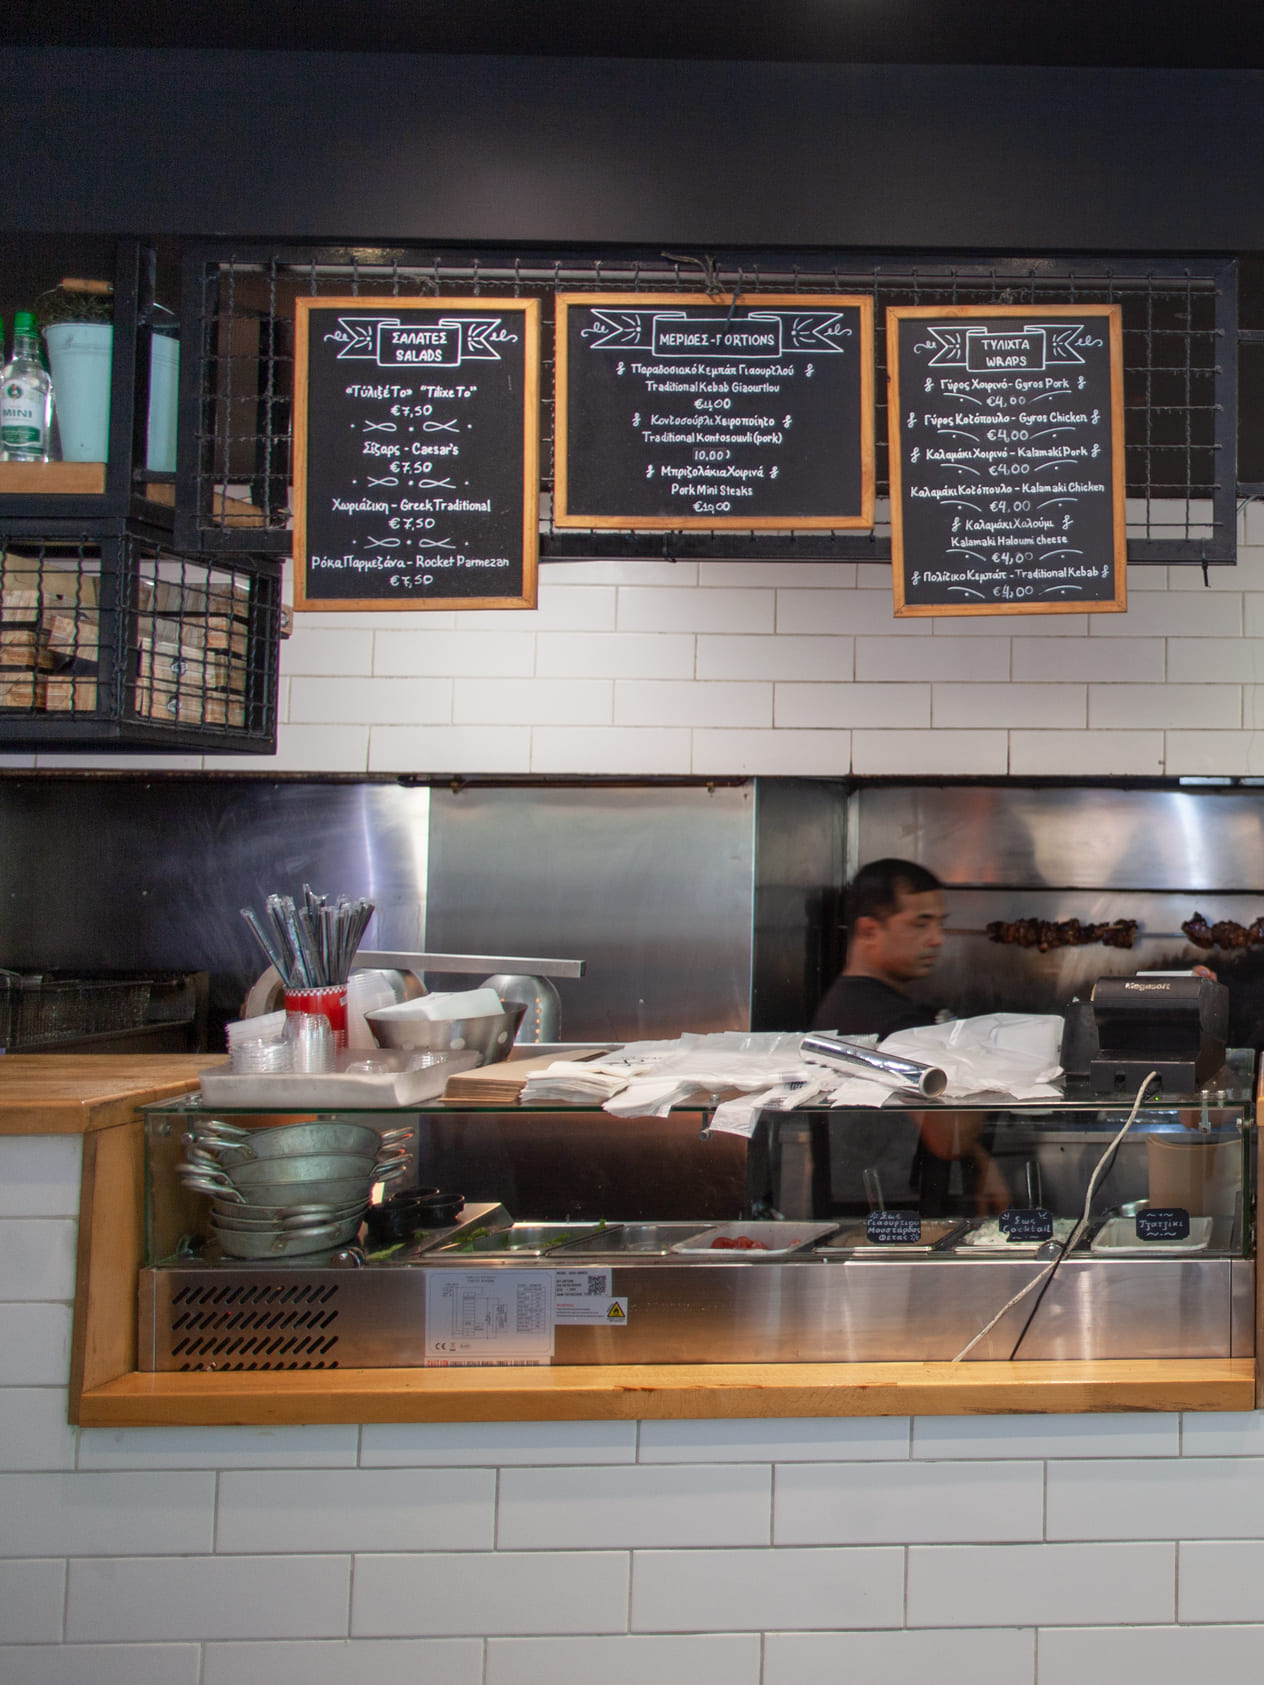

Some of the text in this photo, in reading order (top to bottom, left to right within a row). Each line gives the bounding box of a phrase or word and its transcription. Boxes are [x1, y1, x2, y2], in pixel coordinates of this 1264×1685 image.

[392, 332, 448, 345] ΣΑΛΑΤΕΣ
[981, 339, 1030, 350] ΤΥΛΙΧΤΑ
[395, 348, 443, 362] SALADS
[985, 355, 1027, 367] WRAPS
[631, 363, 697, 377] Παραδοσιακό
[698, 363, 737, 377] Κεμπάπ
[645, 380, 780, 393] Traditional Kebab Giaourtlou
[940, 379, 970, 393] Γύρος
[971, 378, 1008, 393] Χοιρινό
[1014, 379, 1043, 391] Gyros
[1045, 378, 1070, 390] Pork
[2, 408, 32, 419] MINI
[390, 404, 433, 418] €7,50
[651, 414, 775, 429] Κοντοσούβλι Χειροποίητο
[924, 414, 954, 428] Γύρος
[955, 412, 1010, 426] Κοτόπουλο
[1018, 412, 1047, 426] Gyros
[1049, 411, 1088, 423] Chicken
[642, 431, 783, 445] Traditional Kontosouvli (pork)
[987, 429, 1029, 443] €4,00
[926, 448, 973, 463] Καλαμάκι
[973, 447, 1008, 462] Χοιρινό
[1017, 446, 1063, 458] Kalamaki
[1063, 446, 1088, 457] Pork
[660, 465, 764, 480] Μπριζολάκια Χοιρινά
[988, 463, 1030, 476] €4,00
[671, 483, 753, 496] Pork Mini Steaks
[910, 485, 957, 499] Καλαμάκι
[958, 484, 1012, 496] Κοτόπουλο
[1022, 482, 1067, 494] Kalamaki
[1068, 481, 1105, 493] Chicken
[332, 498, 389, 515] Χωριάτικη
[400, 499, 432, 512] Greek
[432, 499, 491, 512] Traditional
[965, 517, 1054, 532] Καλαμάκι Χαλούμι
[951, 536, 996, 547] Kalamaki
[997, 535, 1035, 547] Haloumi
[415, 554, 455, 567] Rocket
[456, 555, 509, 567] Parmezan
[991, 552, 1033, 565] €4,00
[923, 570, 966, 582] Πολίτικο
[966, 569, 1007, 584] Κεμπάπ
[1014, 567, 1067, 580] Traditional
[1067, 565, 1099, 577] Kebab
